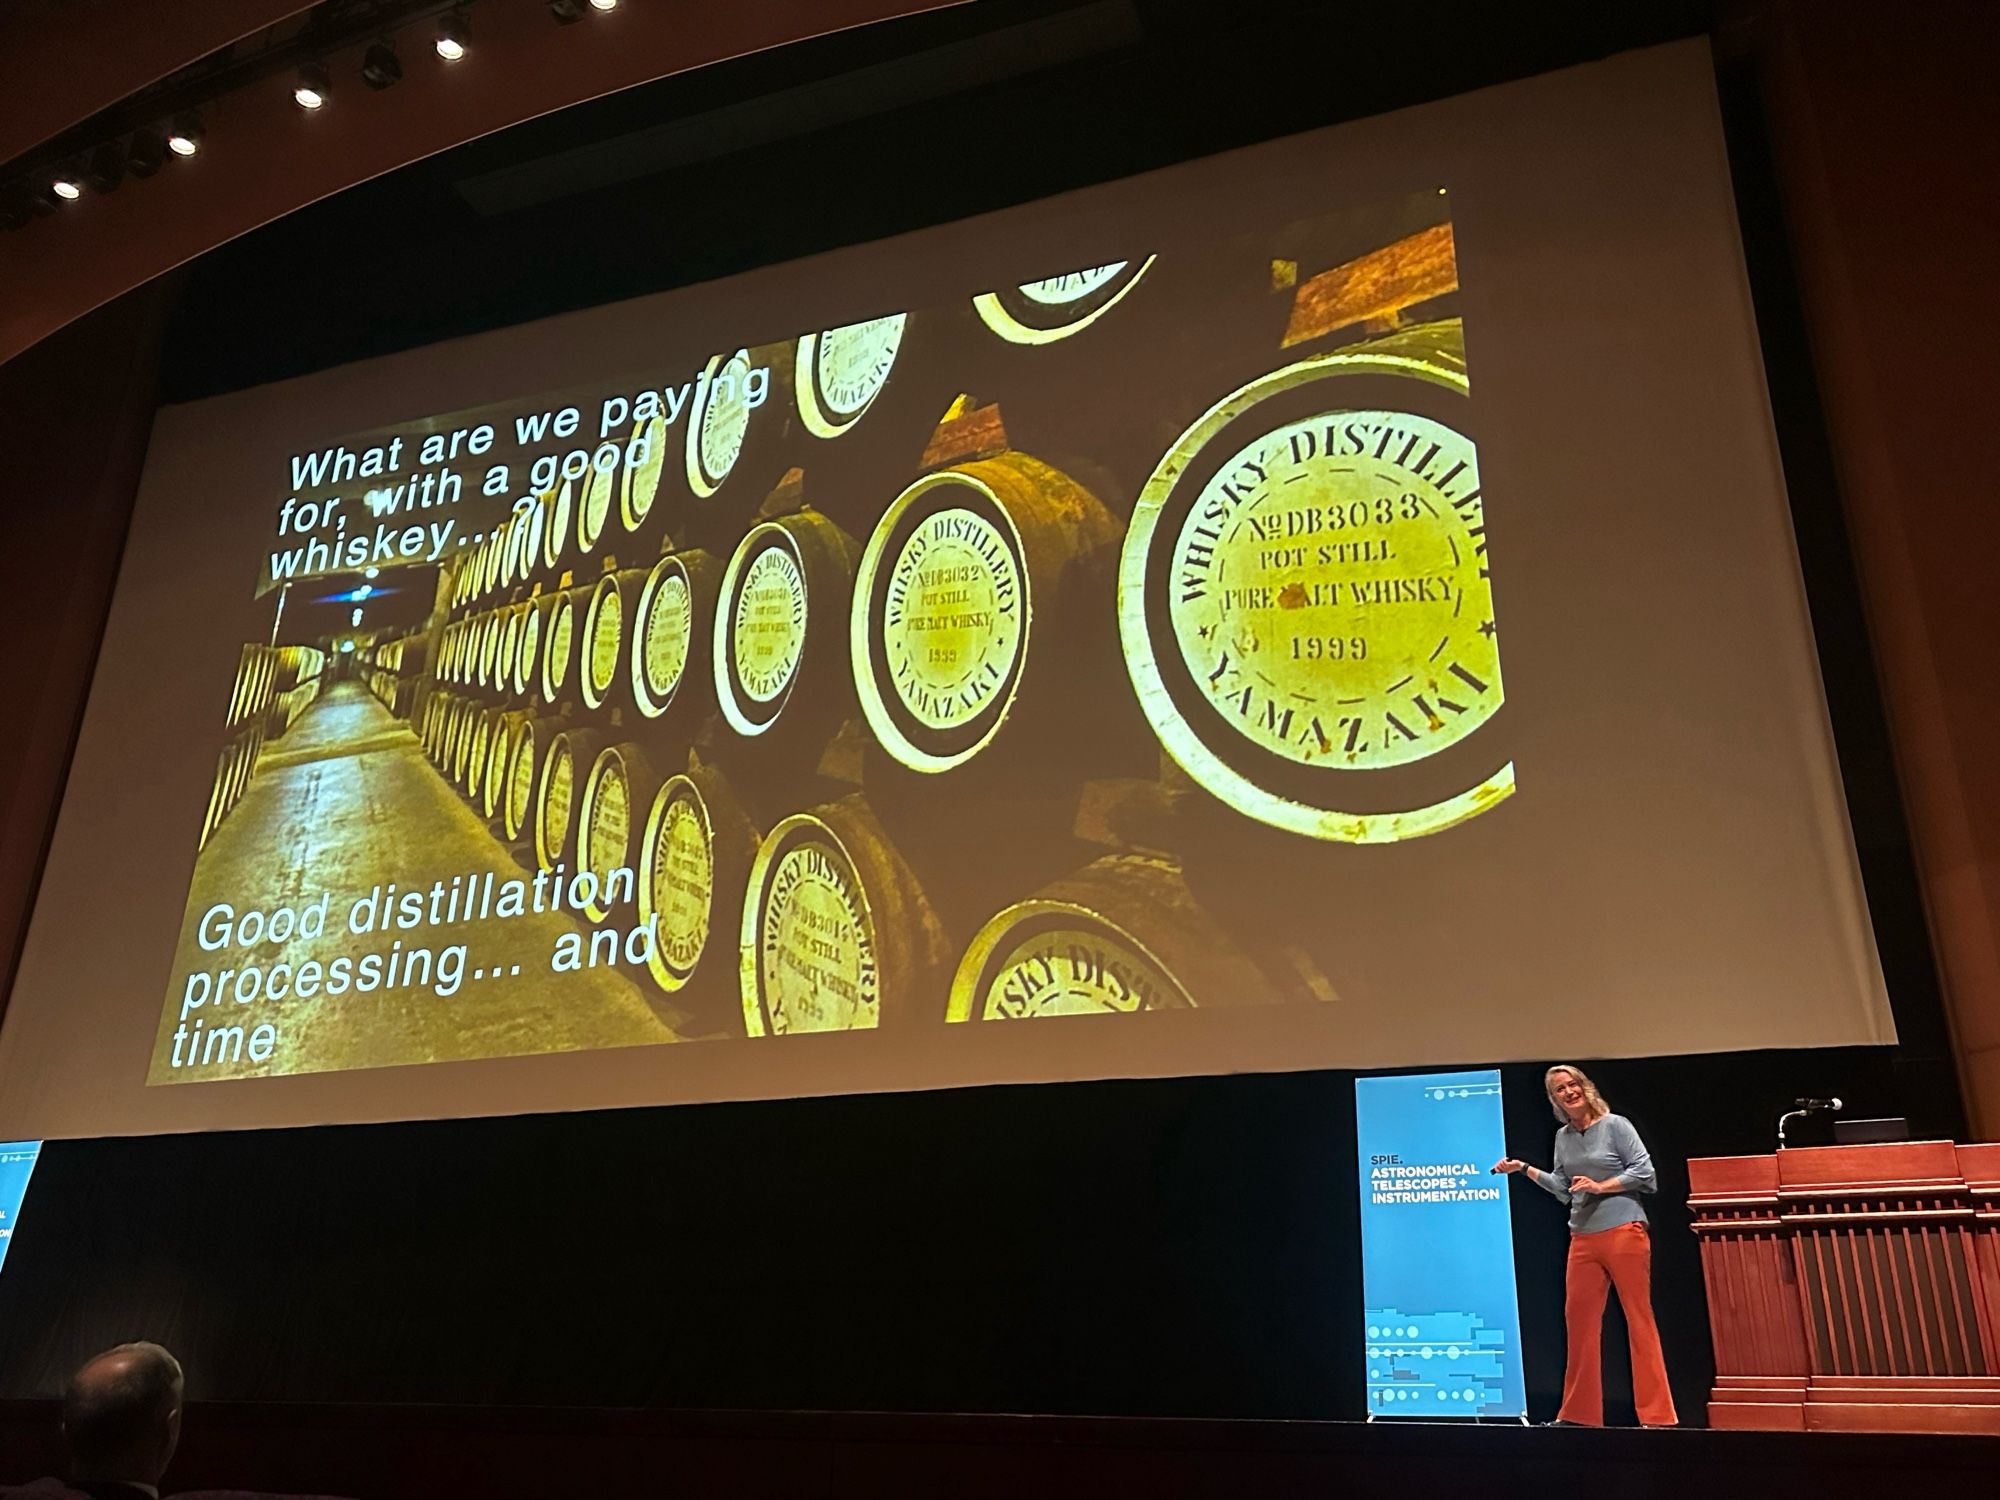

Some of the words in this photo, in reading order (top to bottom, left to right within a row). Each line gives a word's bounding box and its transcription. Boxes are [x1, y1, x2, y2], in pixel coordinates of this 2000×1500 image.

[290, 442, 402, 491] What
[419, 422, 495, 464] are
[515, 406, 581, 445] we
[600, 366, 771, 438] paying
[278, 496, 348, 536] for,
[370, 468, 462, 518] with
[483, 465, 509, 496] a
[529, 427, 653, 496] good
[1182, 449, 1270, 604] WHISKY
[890, 529, 927, 627] WHISKY
[933, 518, 1015, 622] DISTILLERY
[1260, 548, 1307, 570] POT
[1318, 539, 1397, 566] STILL
[940, 590, 970, 604] STILL
[1225, 587, 1275, 610] PURE
[1350, 576, 1454, 605] WHISKY
[1292, 637, 1367, 660] 1999
[898, 658, 999, 718] YAMAZAKI
[1209, 651, 1489, 753] YAMAZAKI
[198, 892, 329, 951] Good
[348, 863, 635, 935] distillation
[180, 941, 521, 1021] processing...
[551, 913, 658, 973] and
[169, 1018, 276, 1068] time
[1371, 1154, 1403, 1165] SPIE.
[1371, 1164, 1480, 1179] ASTRONOMICAL
[1372, 1178, 1456, 1191] TELESCOPES
[1372, 1188, 1500, 1204] INSTRUMENTATION
